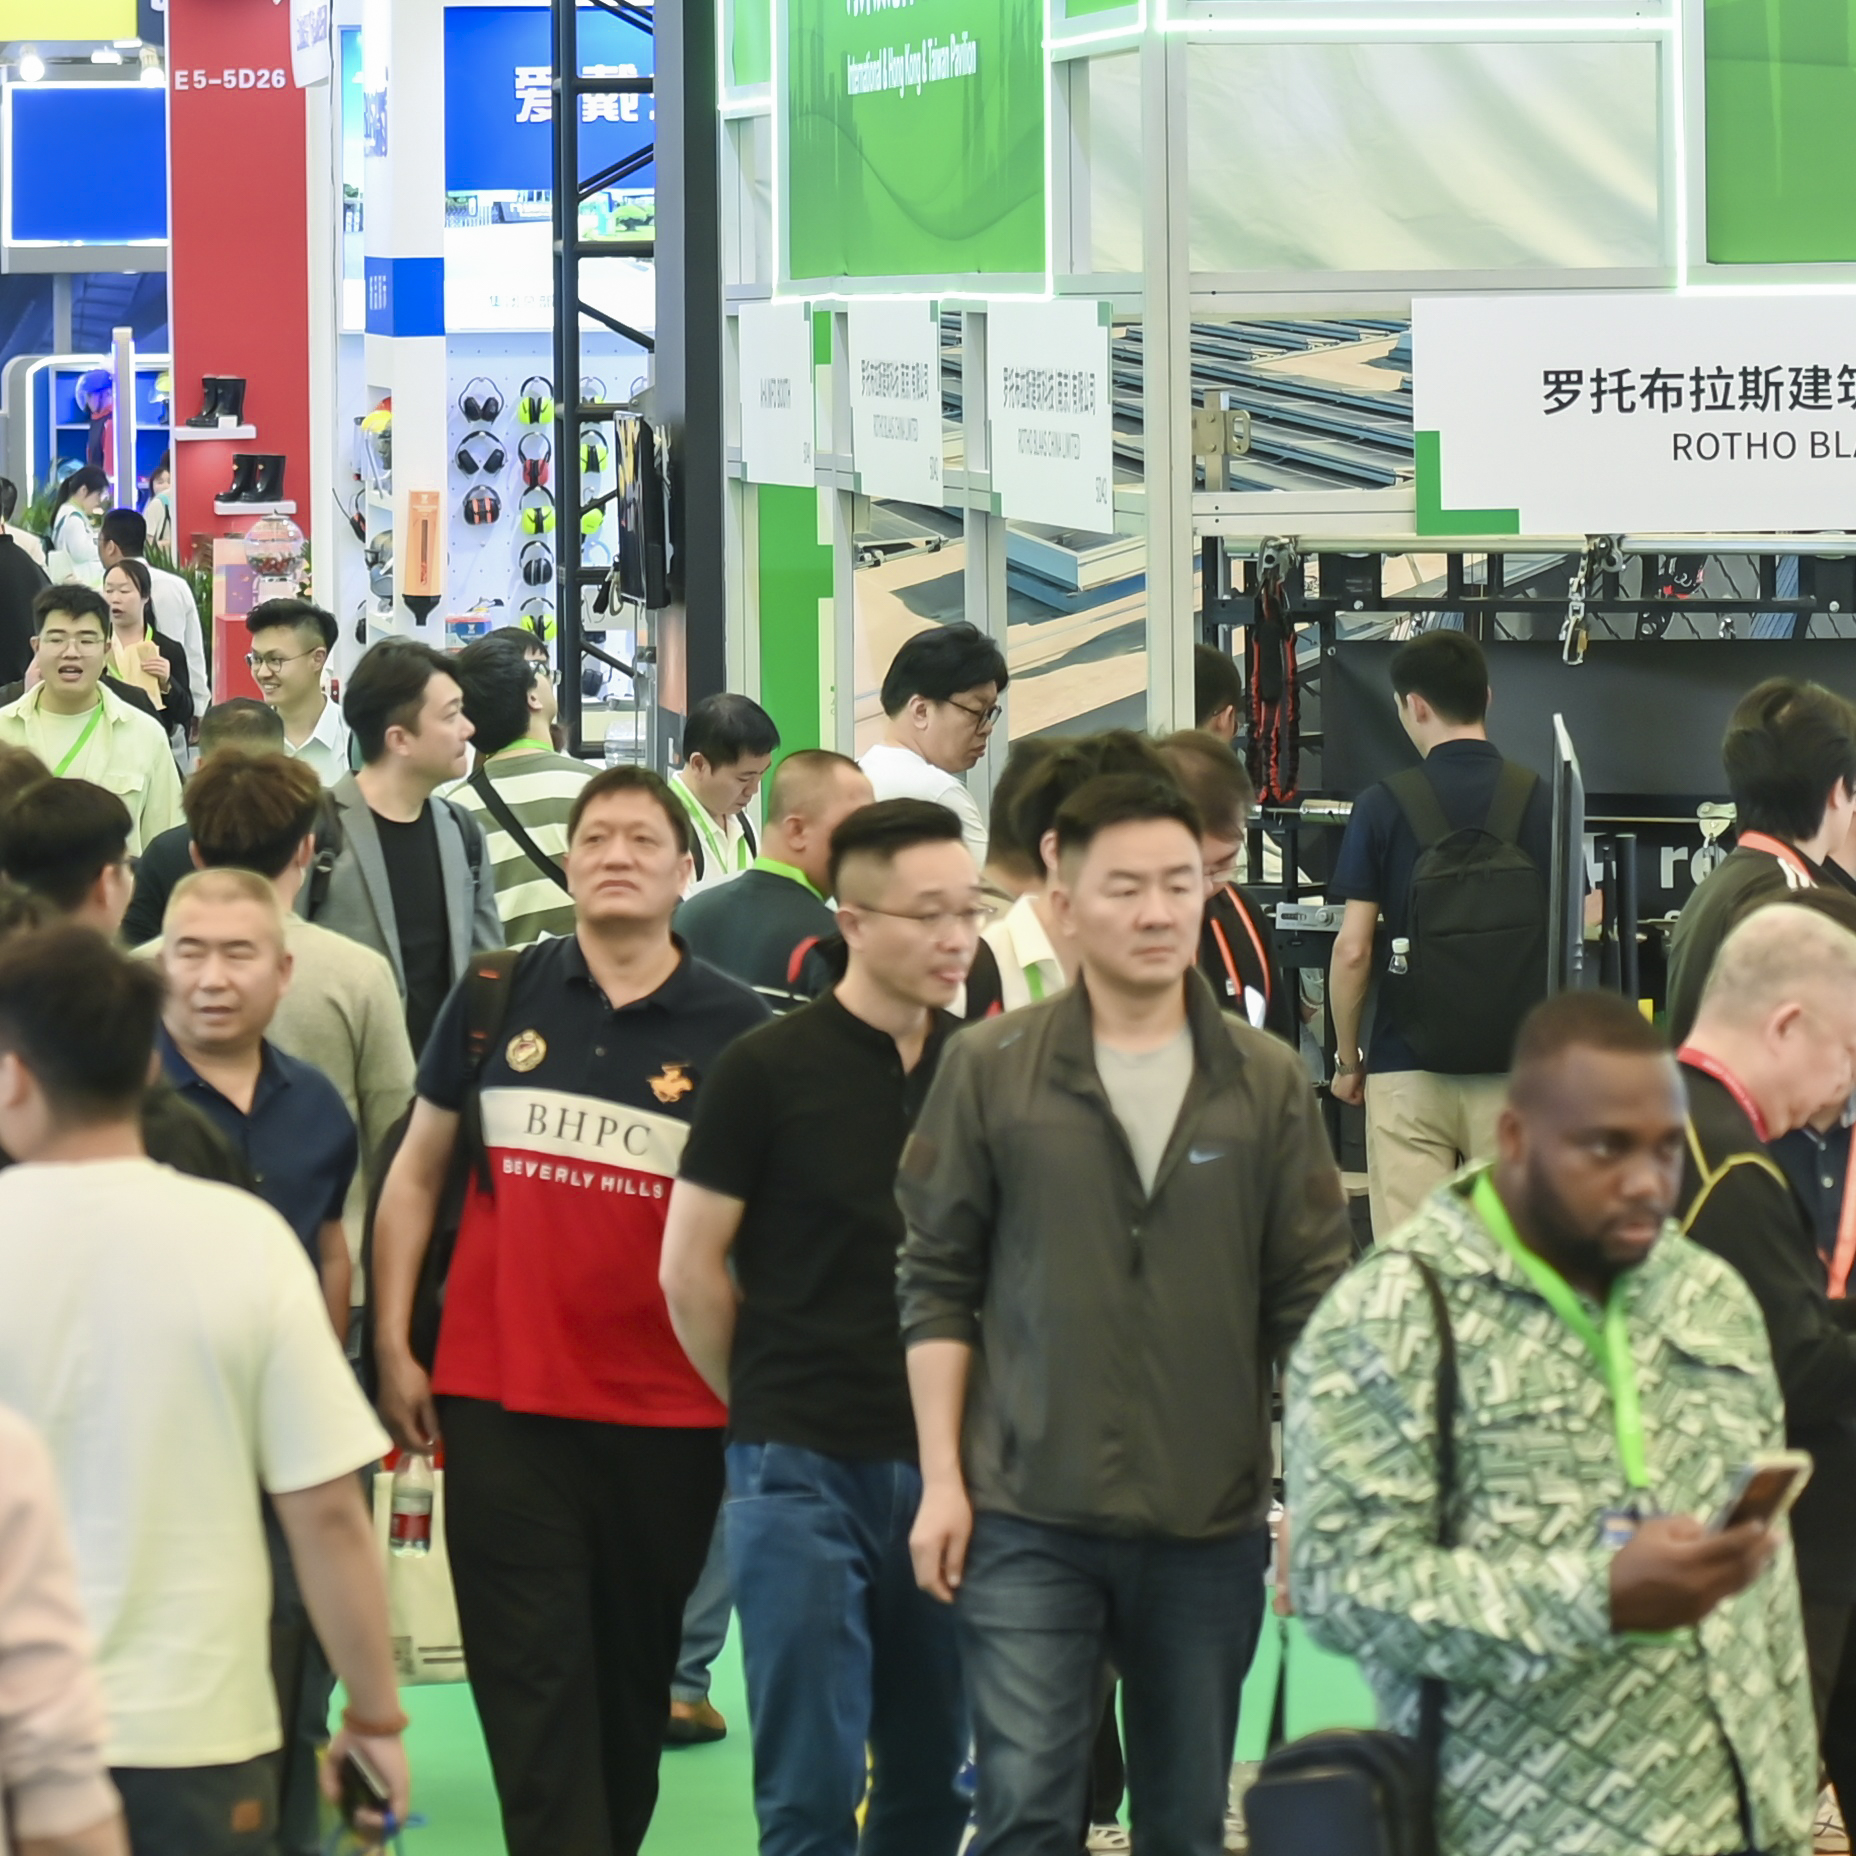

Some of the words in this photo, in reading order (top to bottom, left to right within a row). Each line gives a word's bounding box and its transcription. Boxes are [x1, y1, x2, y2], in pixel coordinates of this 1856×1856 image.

[1672, 431, 1797, 461] ROTHO
[523, 1102, 652, 1156] BHPC
[502, 1157, 595, 1189] BEVERLY
[600, 1175, 664, 1199] HILLS
